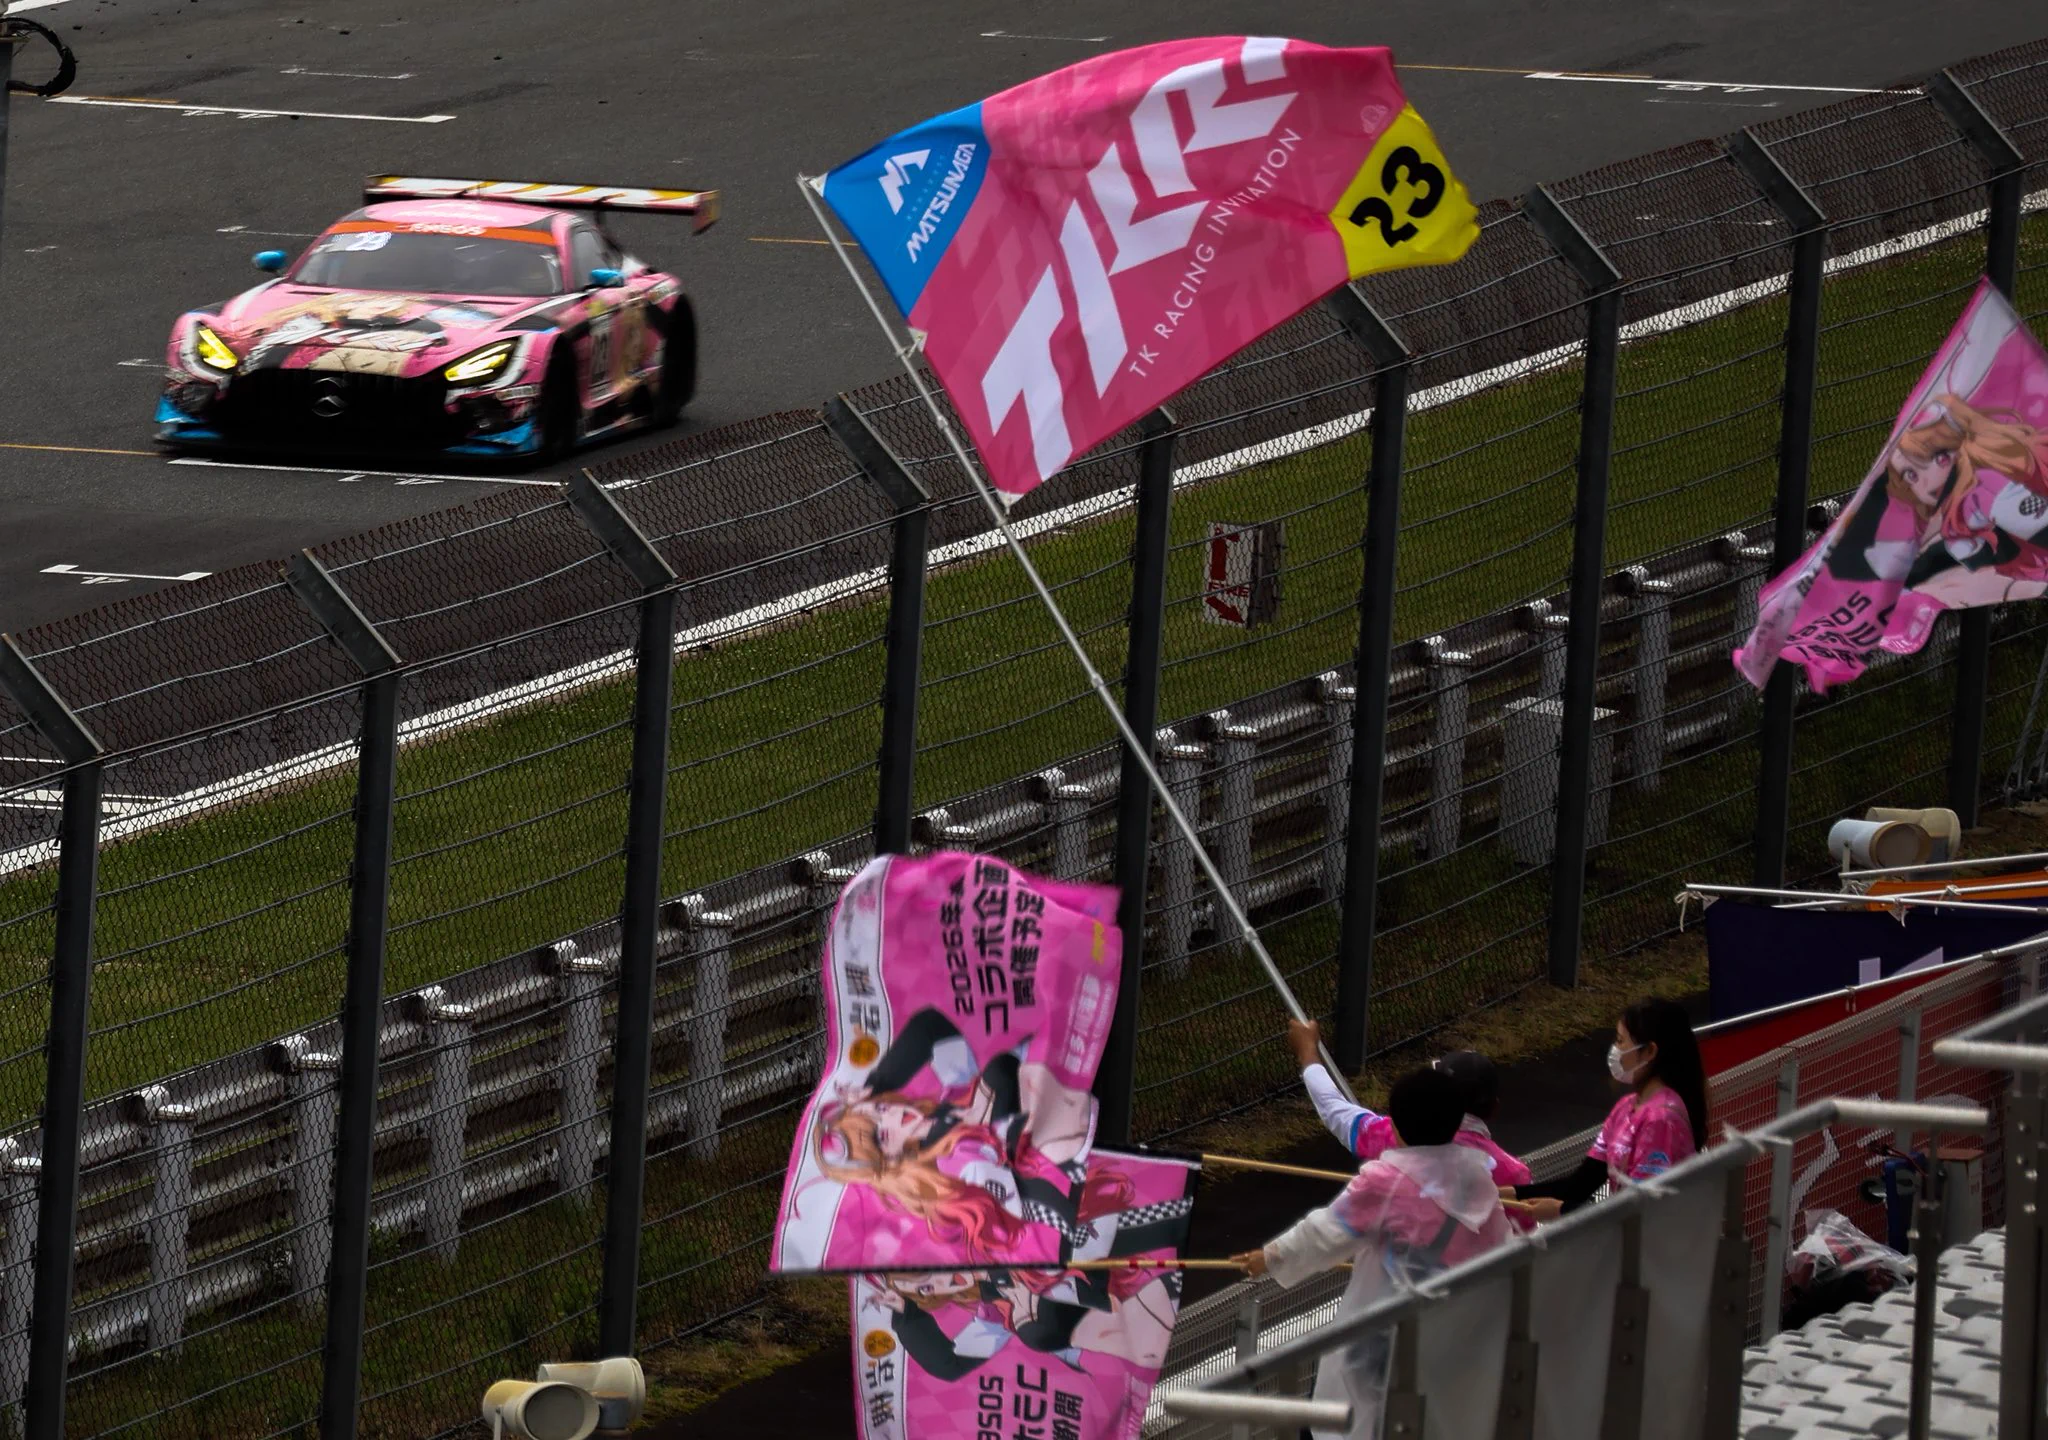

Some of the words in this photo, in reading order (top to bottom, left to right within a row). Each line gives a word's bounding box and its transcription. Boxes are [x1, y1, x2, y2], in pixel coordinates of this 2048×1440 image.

[906, 143, 977, 264] MATSUNAGA
[1129, 345, 1160, 377] TK
[1154, 243, 1215, 339] RACING
[1207, 128, 1302, 235] INVITATION
[1348, 146, 1445, 248] 23
[973, 860, 1009, 1035] コラボ企画
